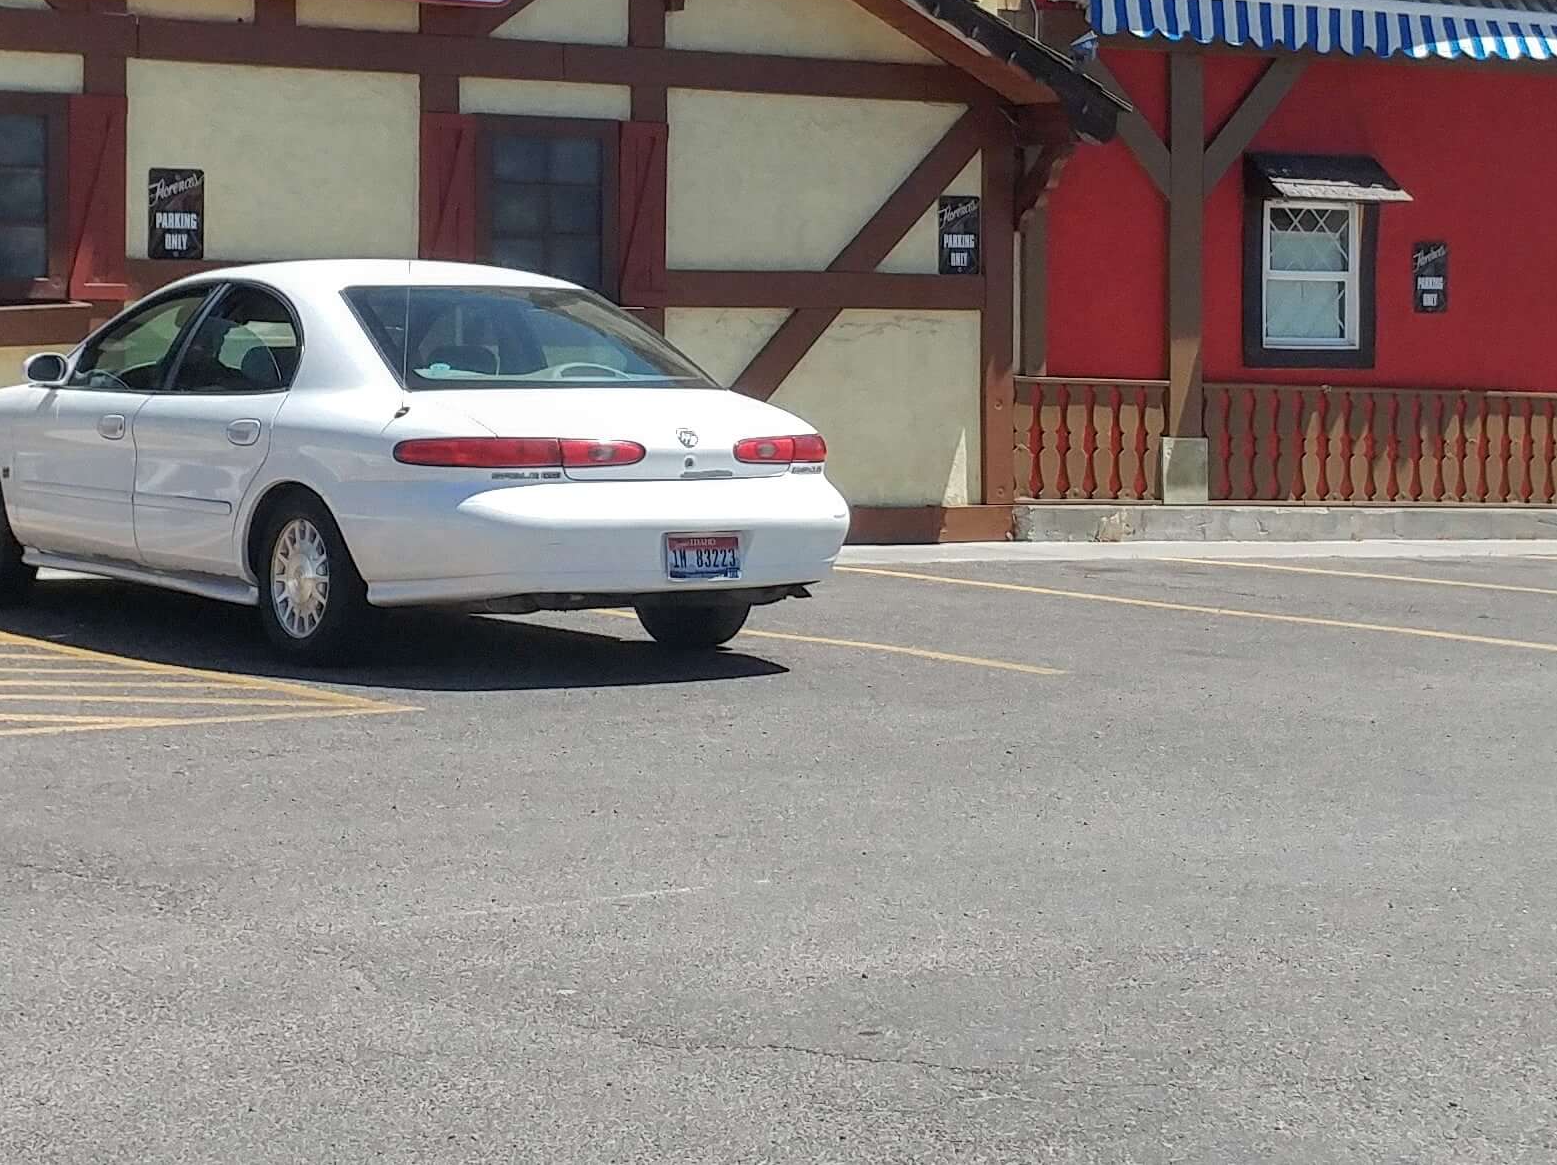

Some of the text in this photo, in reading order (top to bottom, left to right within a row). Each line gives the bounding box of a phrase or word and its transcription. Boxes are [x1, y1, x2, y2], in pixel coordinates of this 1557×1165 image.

[155, 212, 198, 230] PARKING
[164, 233, 188, 251] ONLY
[943, 233, 975, 248] PARKING
[696, 548, 736, 568] 83223
